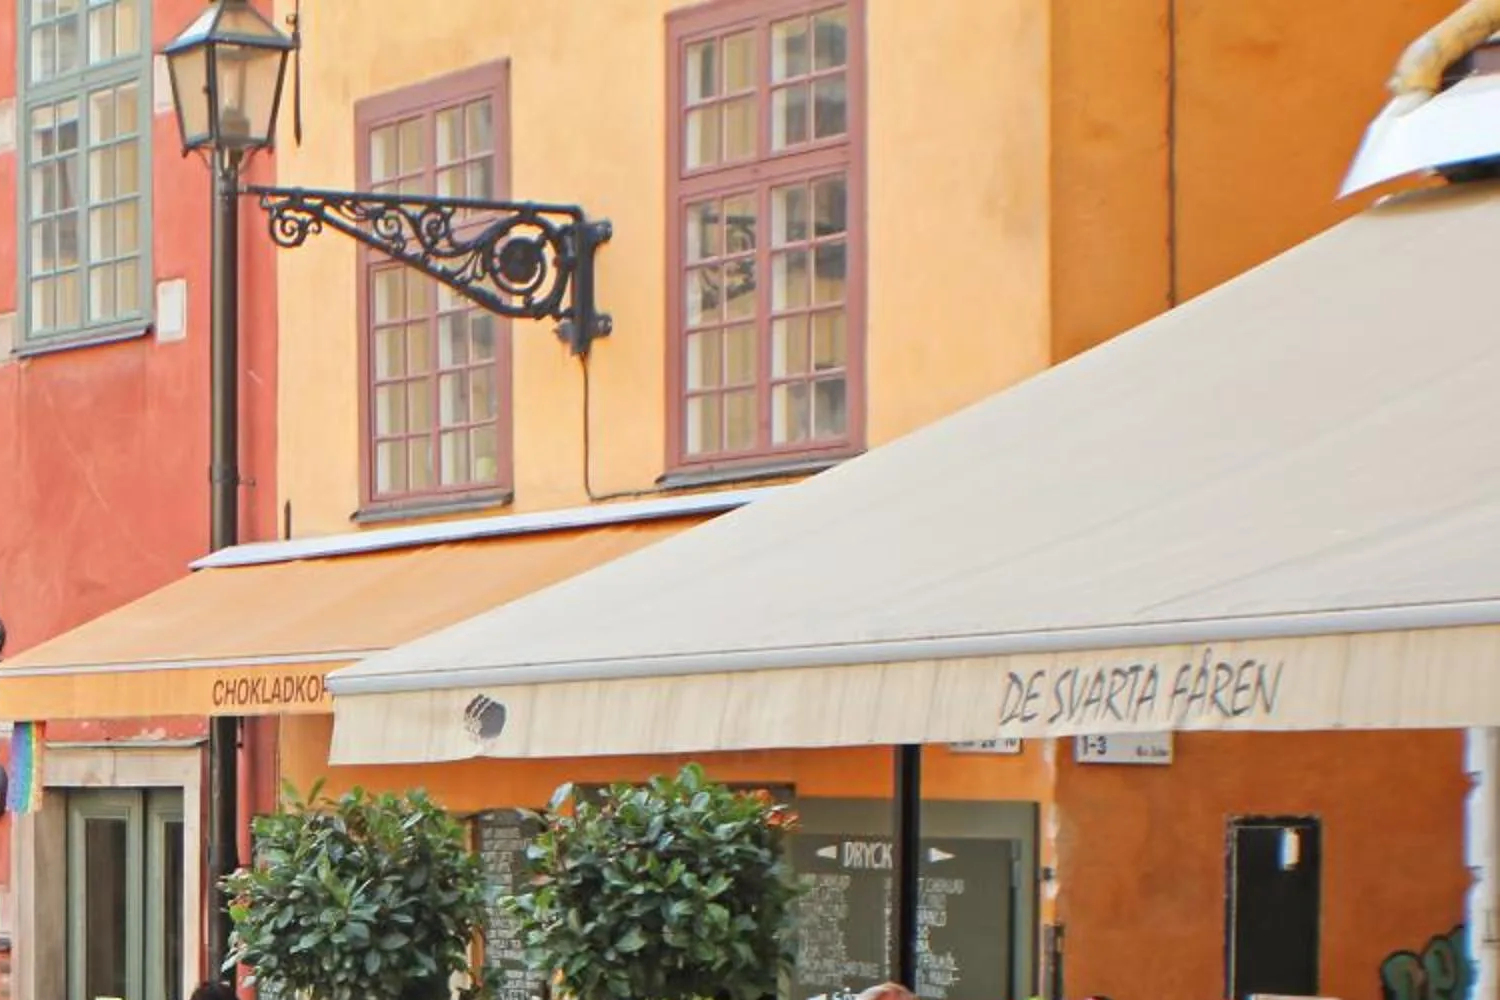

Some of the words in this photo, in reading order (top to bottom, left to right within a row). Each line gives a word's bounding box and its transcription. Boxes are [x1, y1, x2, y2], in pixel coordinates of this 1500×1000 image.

[1000, 669, 1046, 725] DE
[1049, 664, 1160, 724] SVARTA
[1168, 648, 1282, 719] FÅREN
[843, 841, 893, 869] DRYCK
